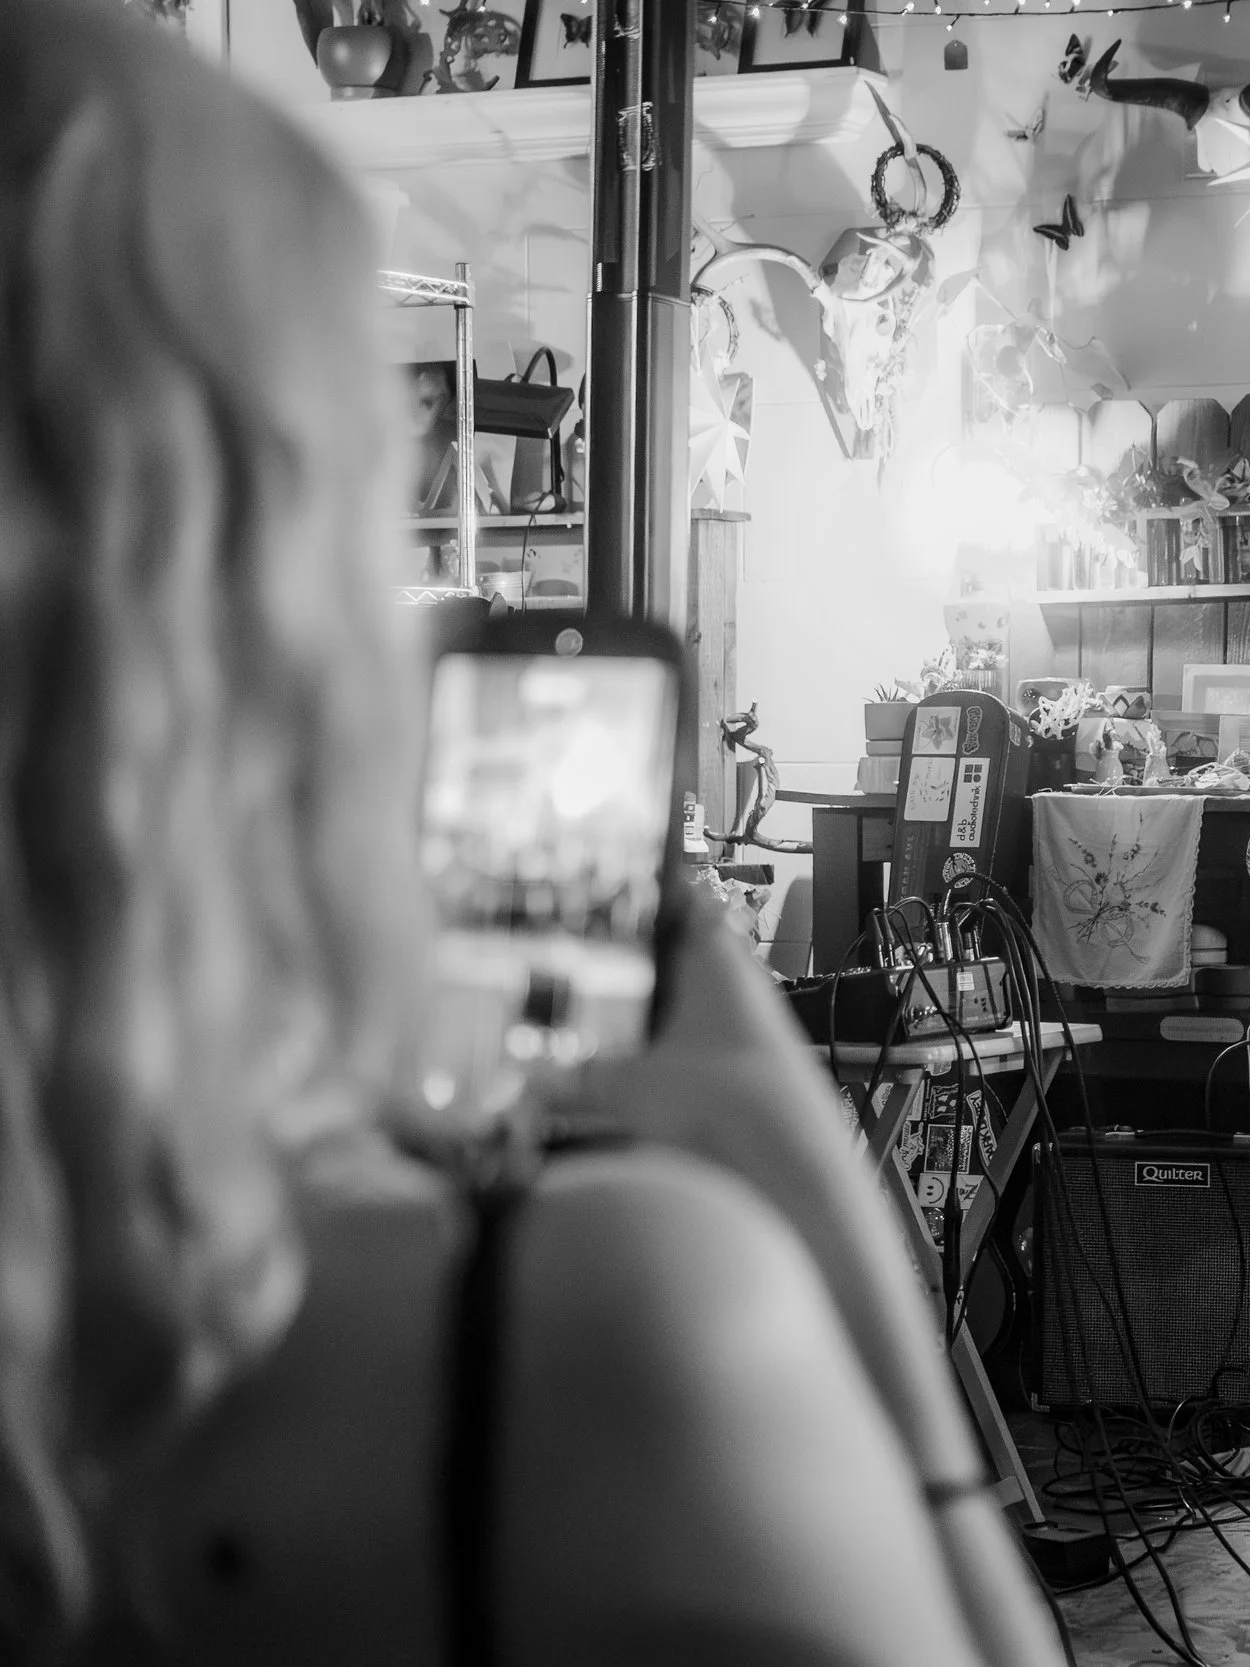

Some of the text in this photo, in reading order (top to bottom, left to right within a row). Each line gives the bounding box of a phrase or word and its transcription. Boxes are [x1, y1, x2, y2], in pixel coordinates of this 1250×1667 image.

[968, 785, 981, 842] audiotechnik
[956, 818, 968, 841] d&b
[1142, 1165, 1204, 1182] Quilter
